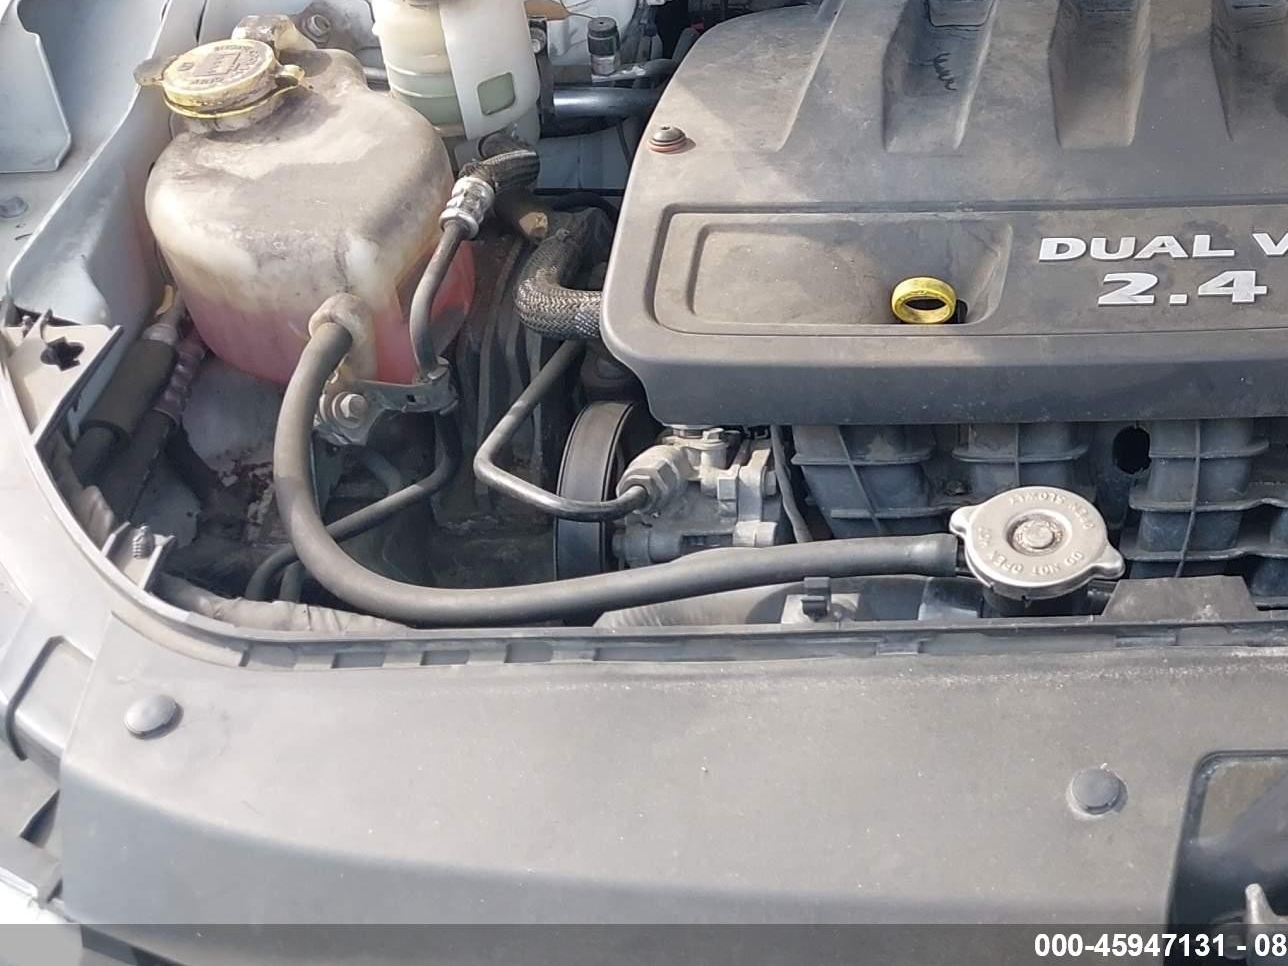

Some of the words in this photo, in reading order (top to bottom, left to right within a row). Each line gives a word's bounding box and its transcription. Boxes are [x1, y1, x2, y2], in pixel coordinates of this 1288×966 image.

[1038, 234, 1235, 262] DUAL
[1097, 269, 1268, 307] 2.4
[990, 551, 1024, 573] OPEN
[1032, 563, 1061, 575] NOT
[1063, 551, 1085, 566] DO
